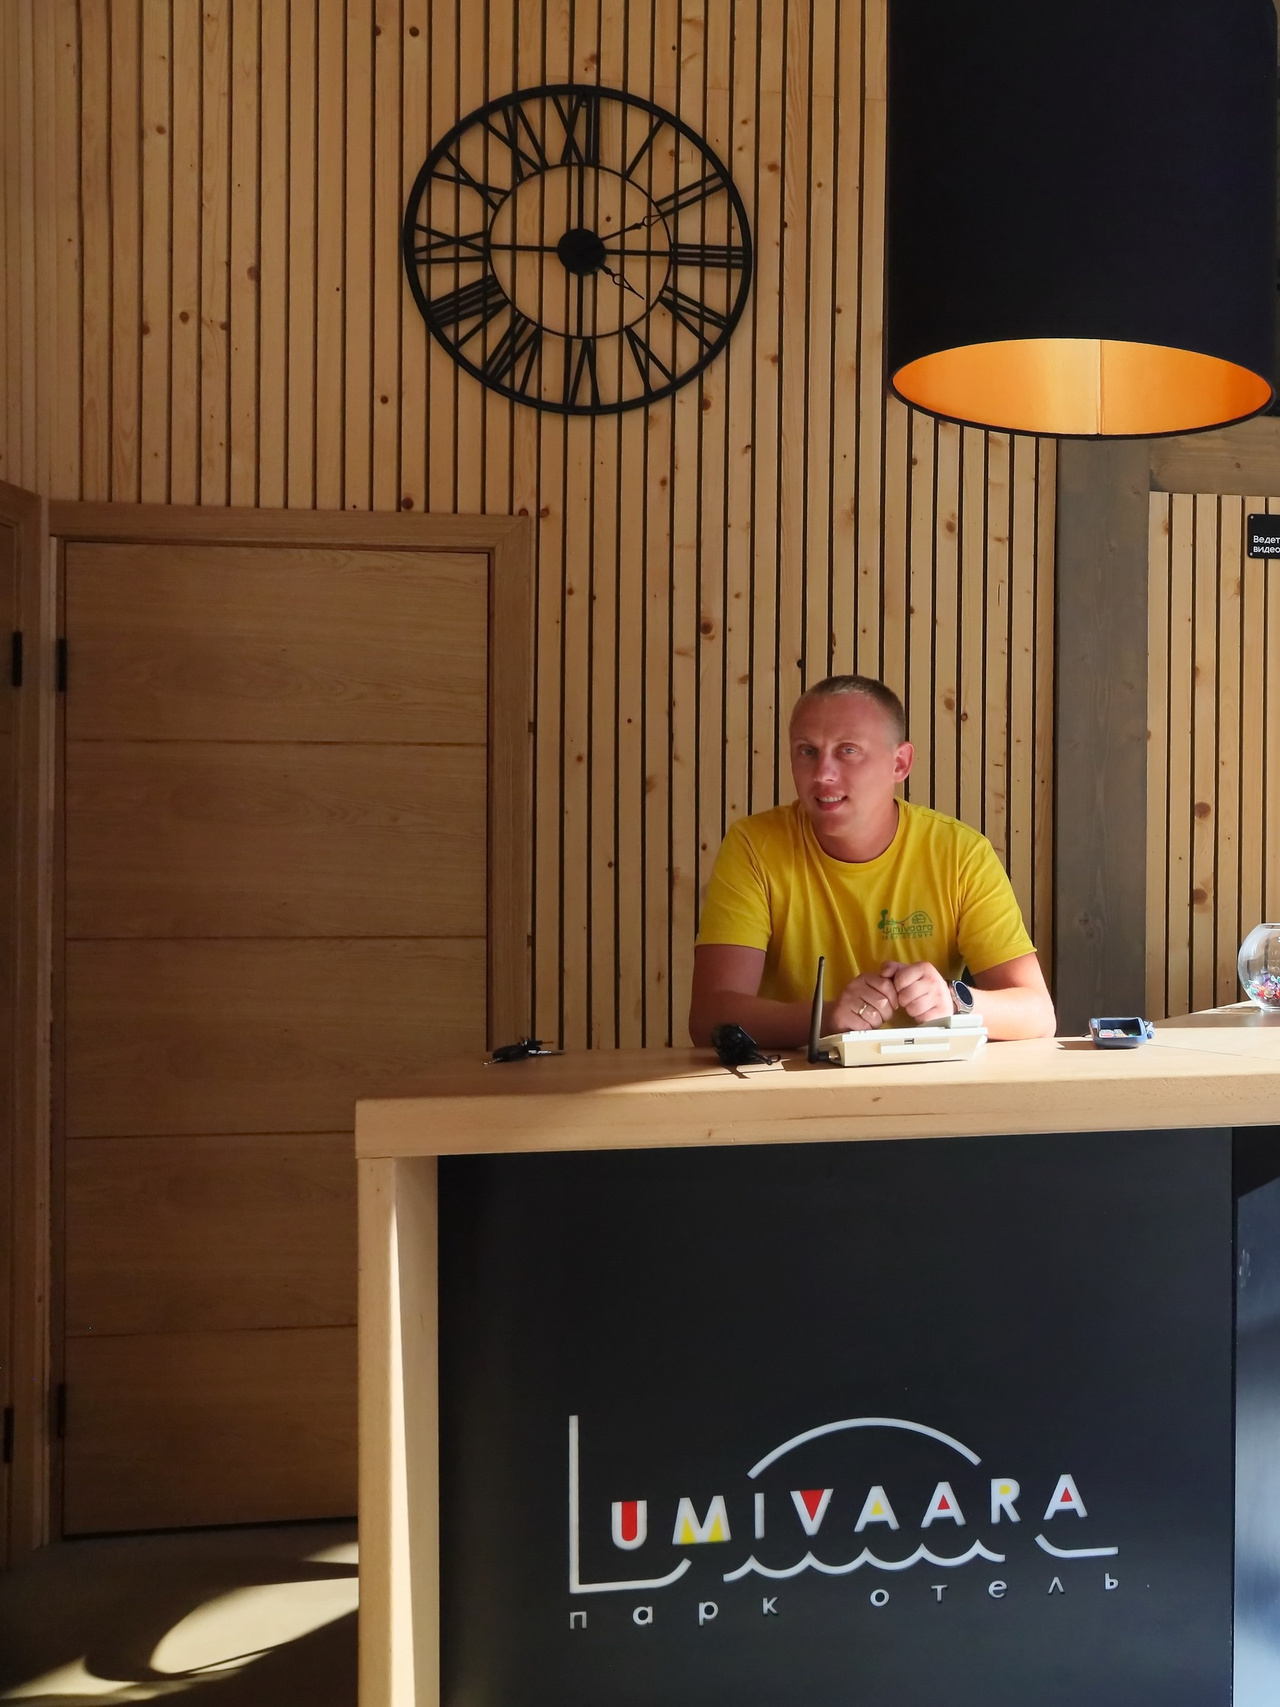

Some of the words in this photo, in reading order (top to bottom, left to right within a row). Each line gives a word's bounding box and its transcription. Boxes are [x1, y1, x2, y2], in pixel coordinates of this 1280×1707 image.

[569, 1415, 1090, 1593] LUMIVAARA
[569, 1594, 779, 1631] парк
[869, 1571, 1120, 1609] отель
